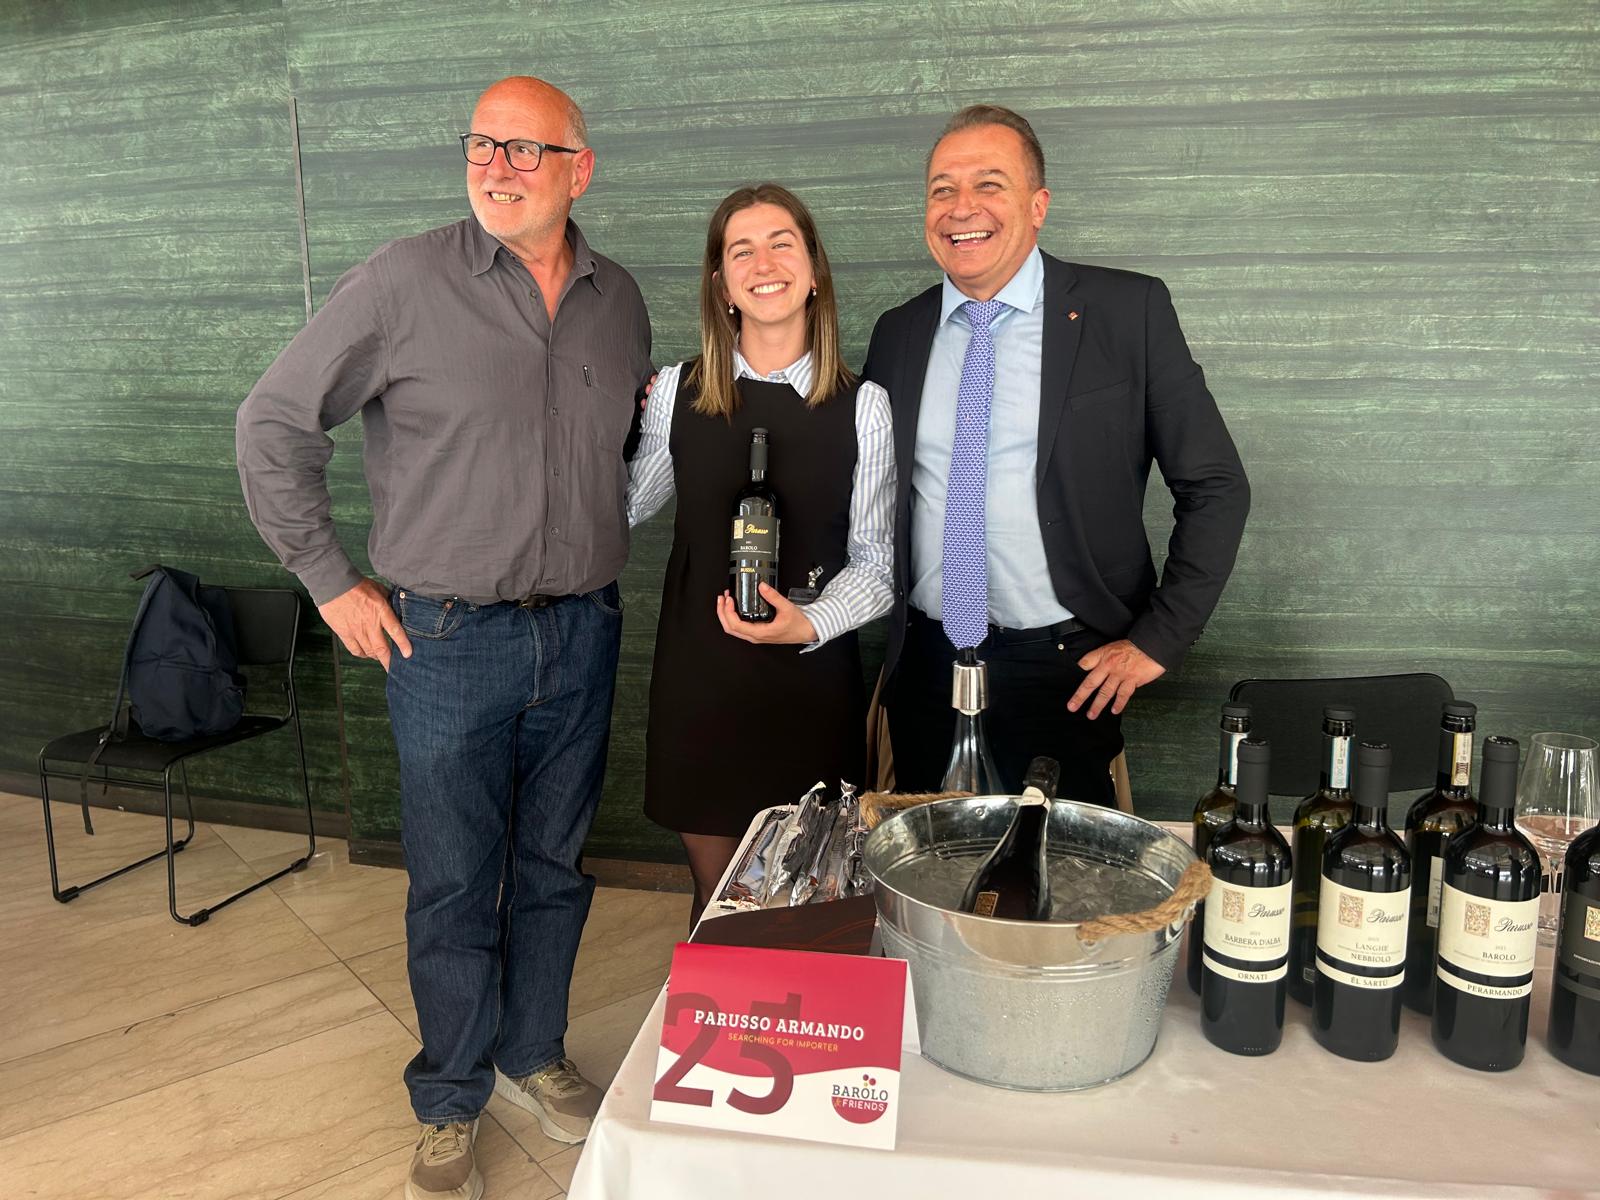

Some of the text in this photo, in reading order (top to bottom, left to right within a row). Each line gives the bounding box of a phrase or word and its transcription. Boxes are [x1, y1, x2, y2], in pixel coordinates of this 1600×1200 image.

[1224, 933, 1257, 946] BARBERA
[1355, 943, 1389, 952] LANGHE
[1350, 952, 1391, 963] NEBBIOLO
[1482, 951, 1516, 961] BAROLO
[1237, 972, 1268, 981] ORNATI
[1467, 983, 1523, 997] PERARMANDO
[693, 1009, 865, 1041] PARUSSO ARMANDO
[727, 1032, 839, 1052] SEARCHING FOR IMPORTER
[653, 992, 803, 1116] 25
[832, 1084, 889, 1101] BAROLO
